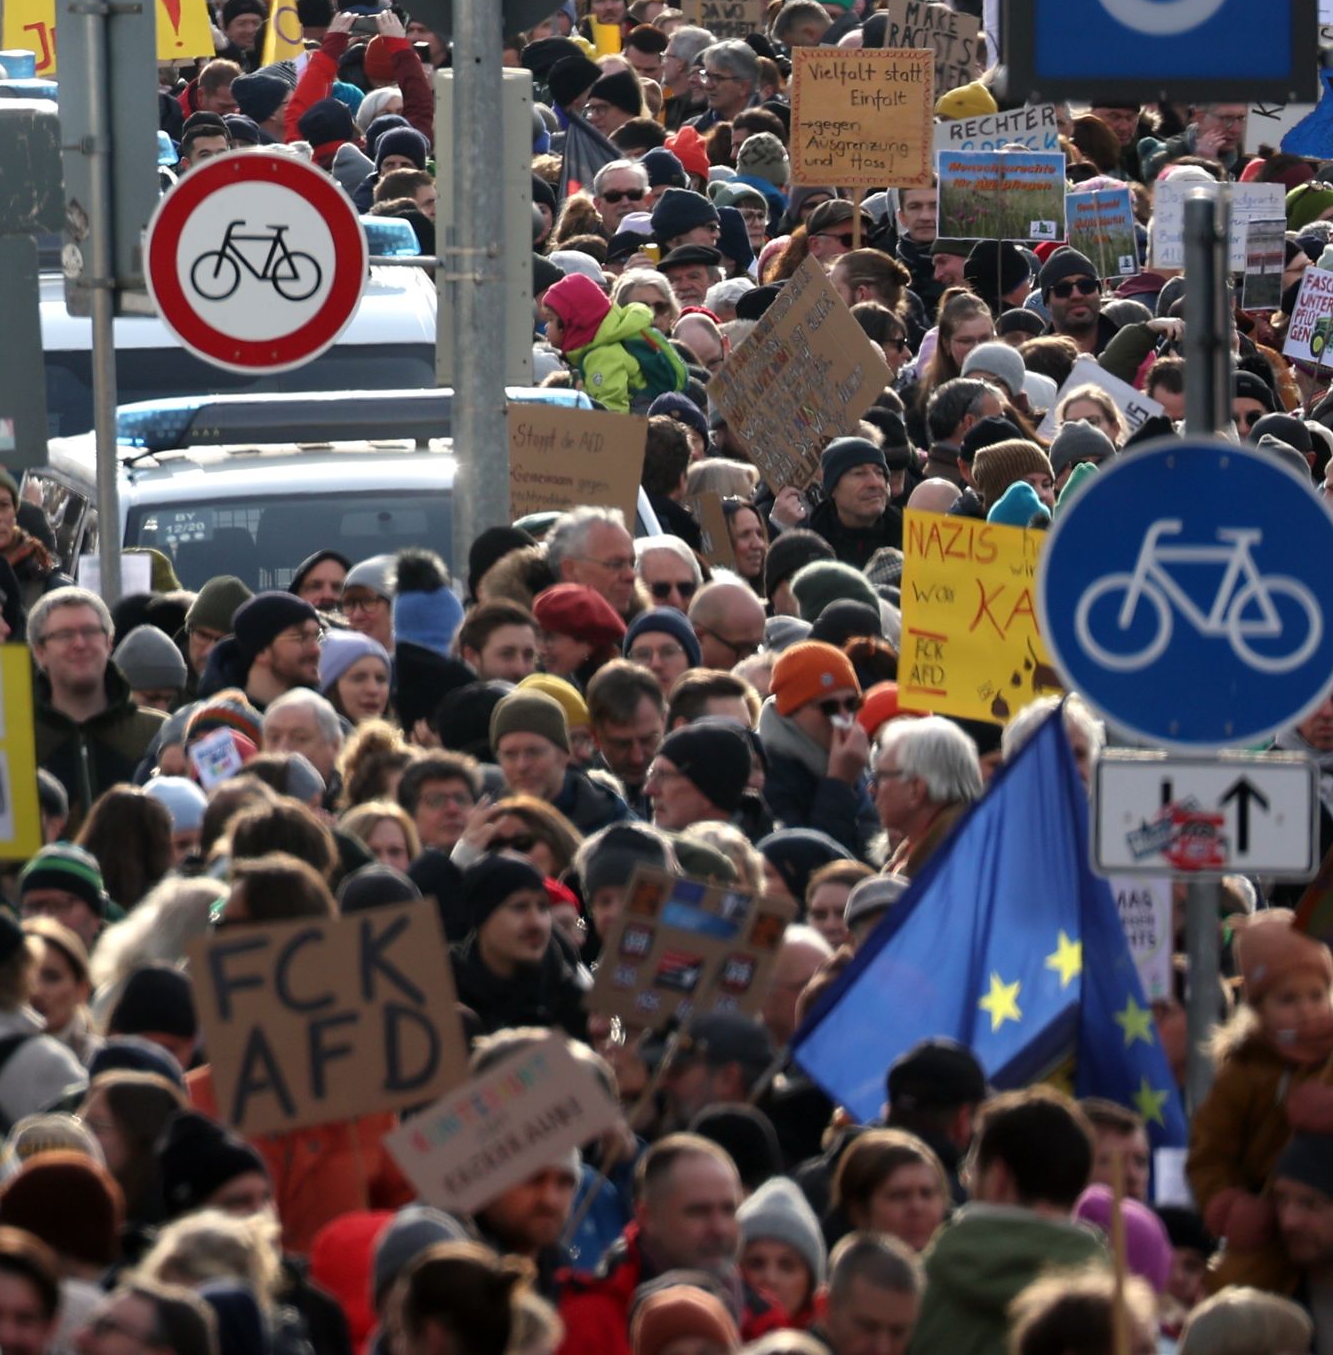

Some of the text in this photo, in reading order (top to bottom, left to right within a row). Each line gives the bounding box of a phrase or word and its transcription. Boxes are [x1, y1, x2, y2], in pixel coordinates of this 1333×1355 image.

[906, 2, 958, 34] MAKE
[808, 62, 876, 86] Vielfalt
[885, 63, 923, 82] statt
[850, 88, 907, 111] Einfalt
[813, 120, 861, 137] gegen
[950, 105, 1055, 141] RECHTER
[805, 136, 909, 158] Ausgrenzung
[804, 153, 833, 167] und
[165, 522, 206, 534] 12/20
[175, 512, 196, 522] BY
[908, 520, 998, 565] NAZIS
[915, 638, 944, 661] FCK
[910, 663, 946, 686] AFD
[206, 915, 427, 1023] FCK
[232, 1006, 443, 1124] AFD
